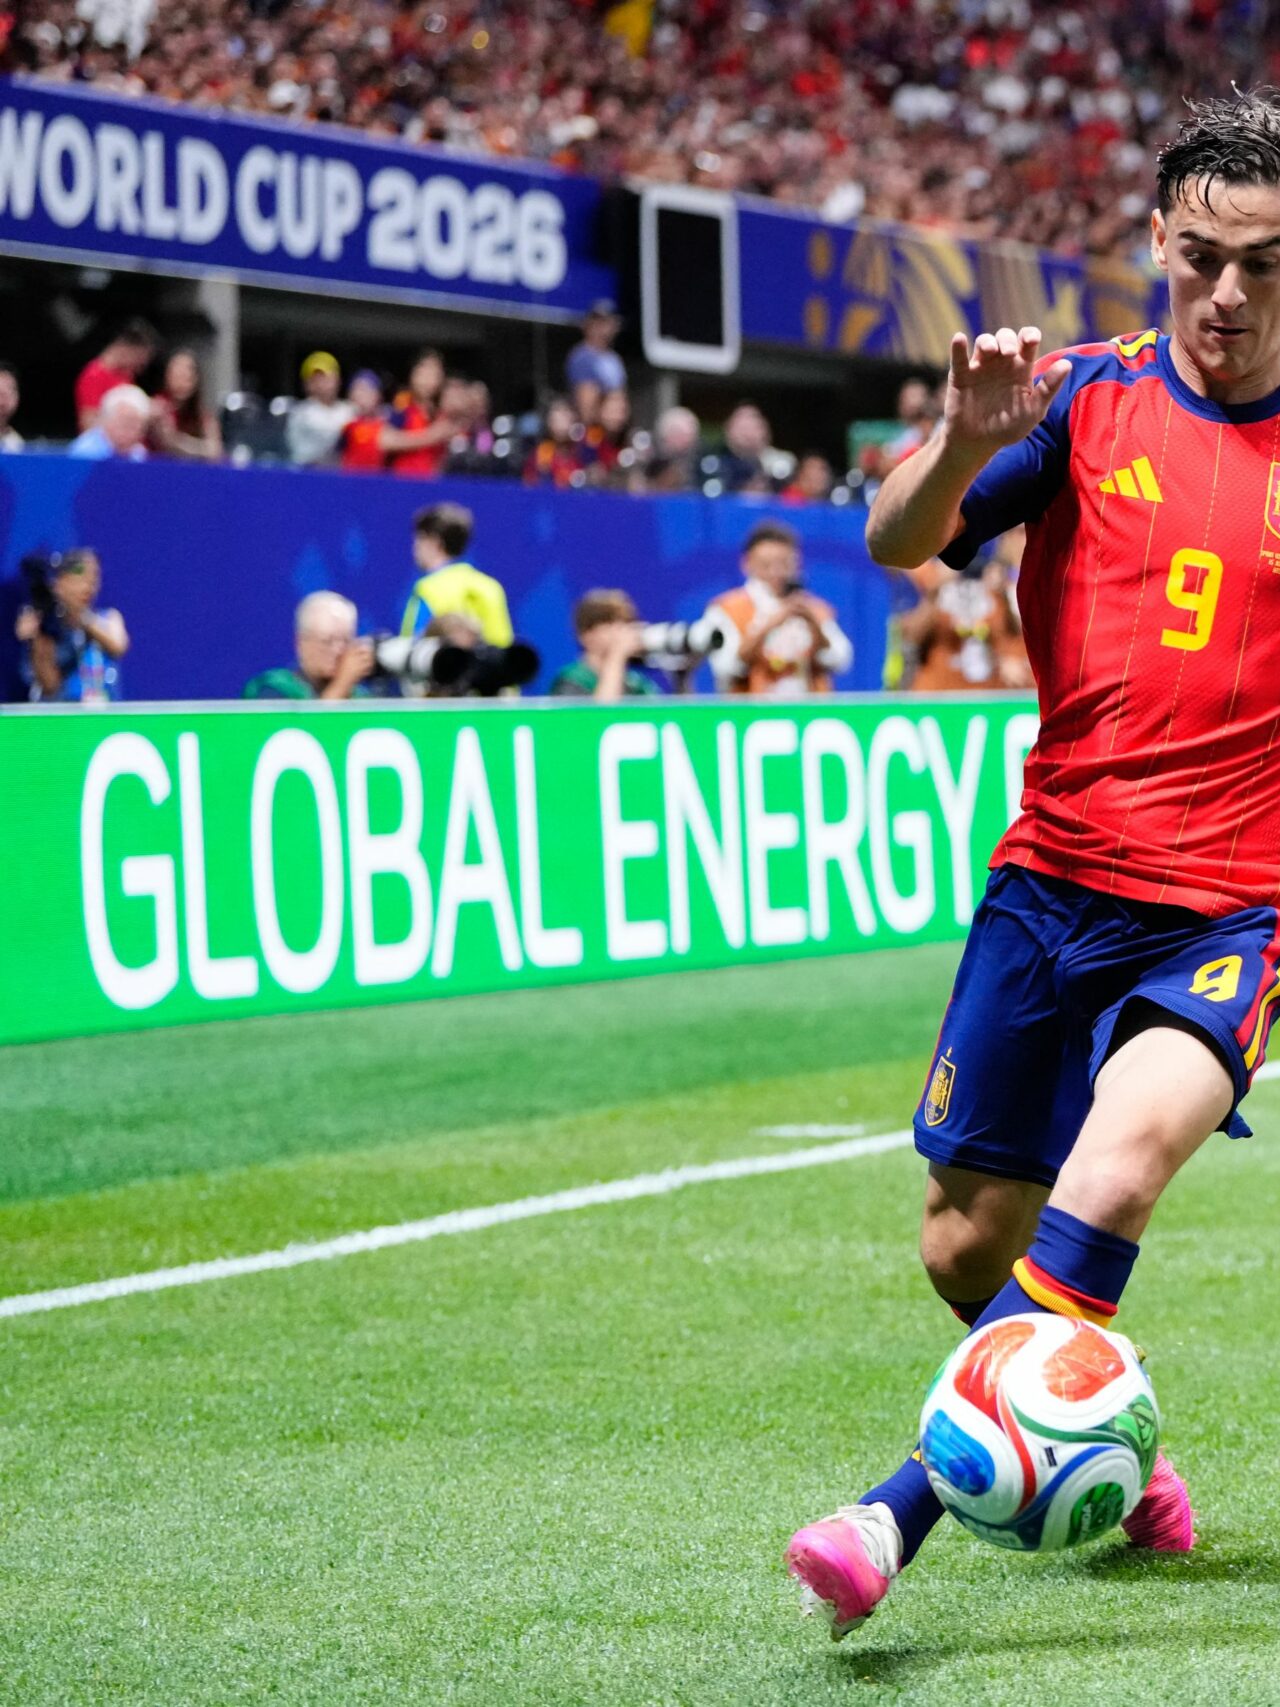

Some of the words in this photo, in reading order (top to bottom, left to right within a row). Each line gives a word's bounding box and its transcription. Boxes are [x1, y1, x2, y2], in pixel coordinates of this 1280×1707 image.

[0, 105, 230, 246] WORLD
[234, 143, 364, 263] CUP
[366, 166, 568, 292] 2026
[1160, 547, 1223, 651] 9
[80, 724, 583, 1010] GLOBAL
[598, 714, 989, 961] ENERGY
[1187, 954, 1244, 1003] 9
